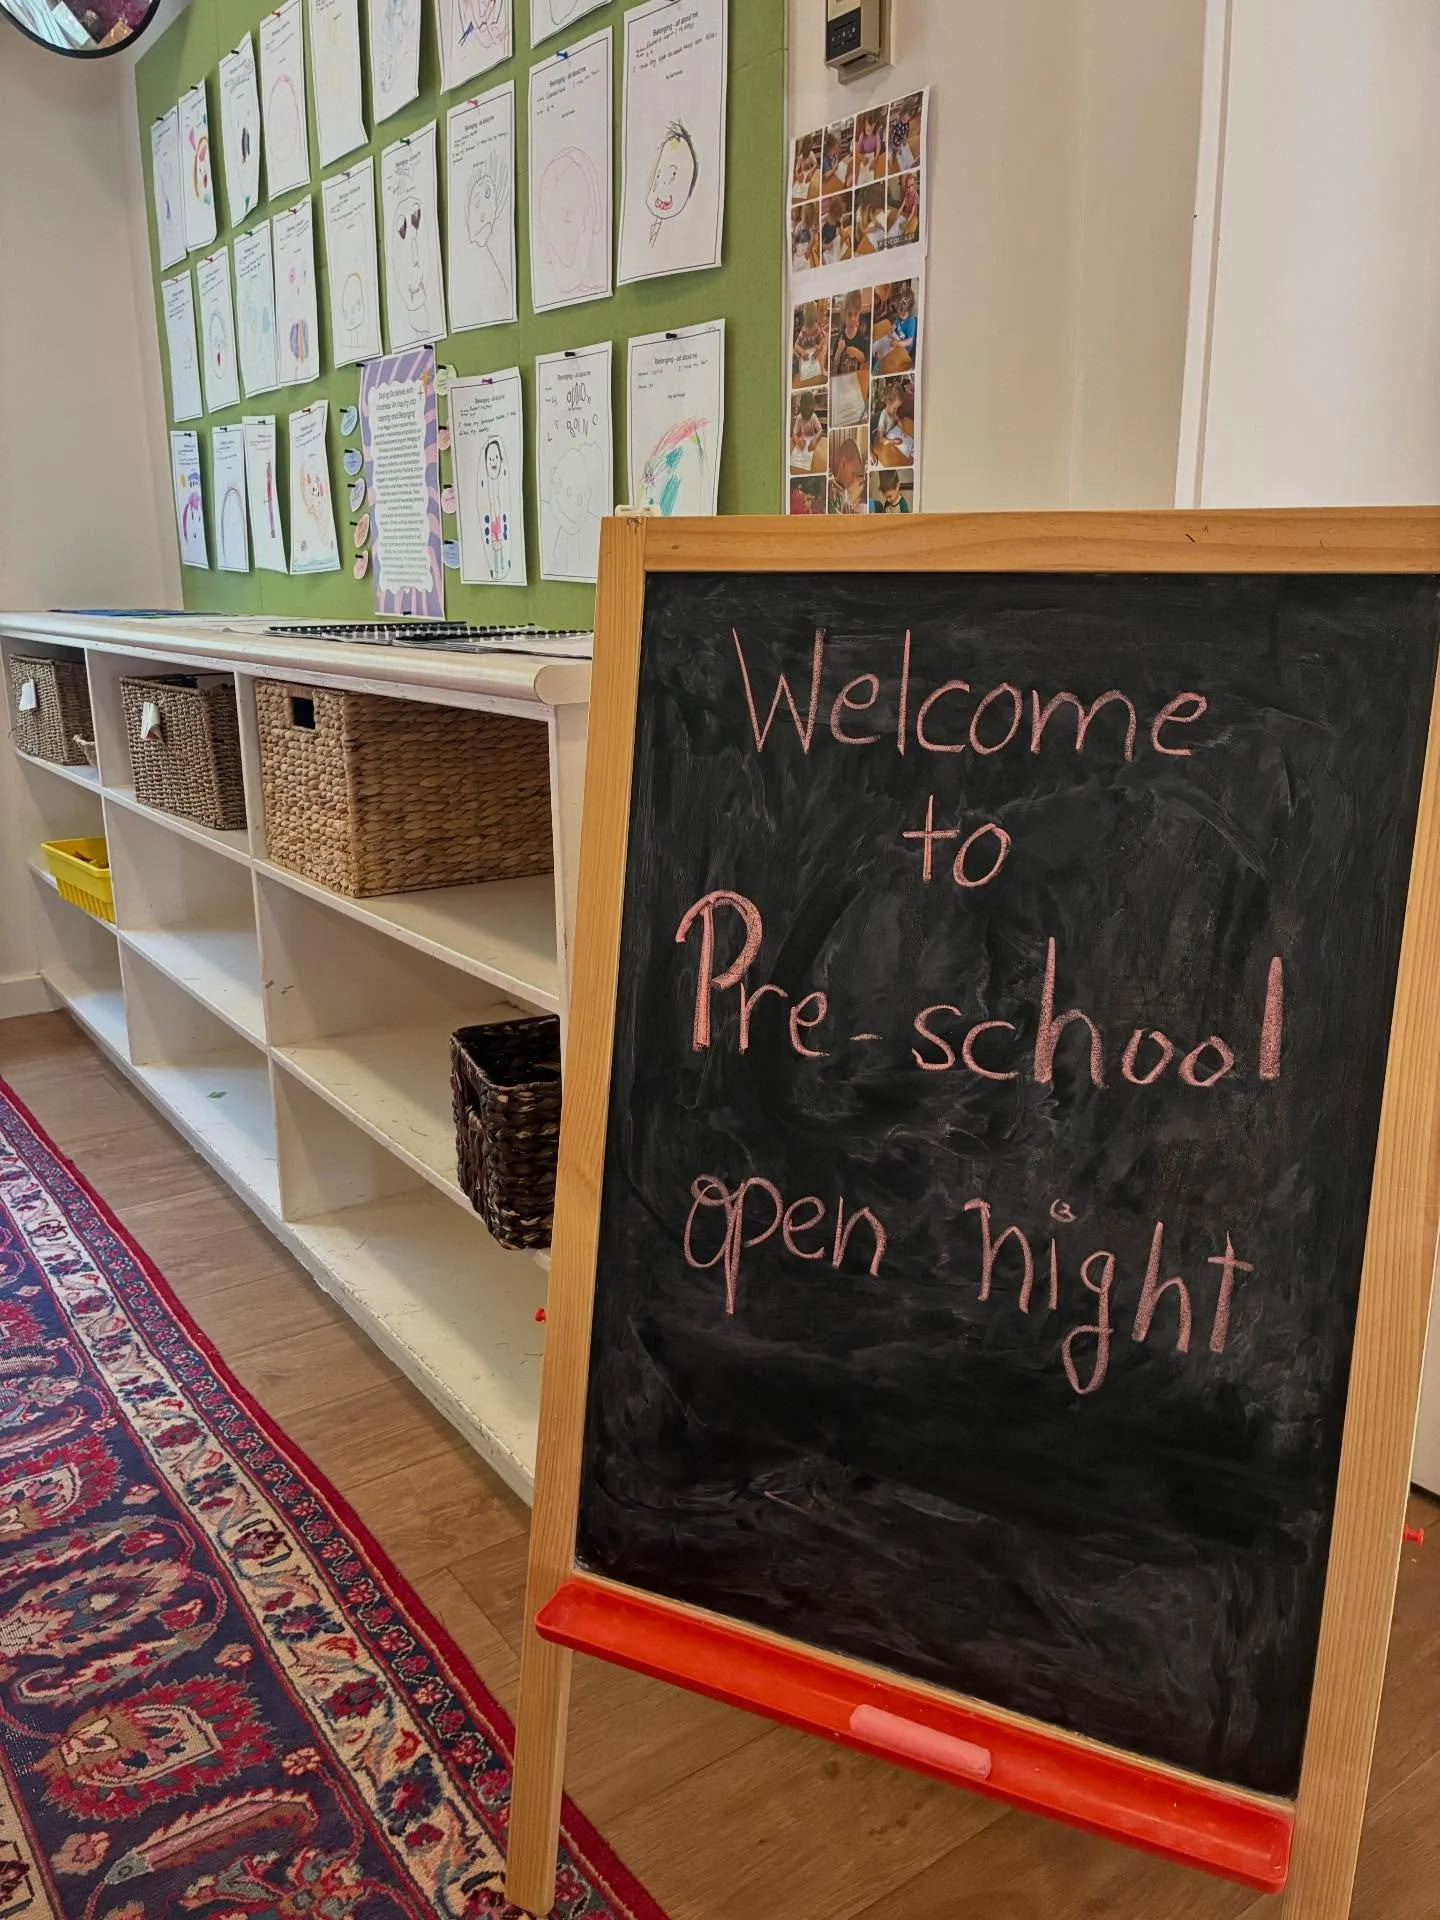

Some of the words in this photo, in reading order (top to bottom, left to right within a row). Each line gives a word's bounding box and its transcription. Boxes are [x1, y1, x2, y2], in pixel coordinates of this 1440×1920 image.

[732, 627, 1208, 762] Welcome
[902, 794, 1012, 887] to
[683, 1173, 889, 1315] open
[963, 1198, 1255, 1395] night
